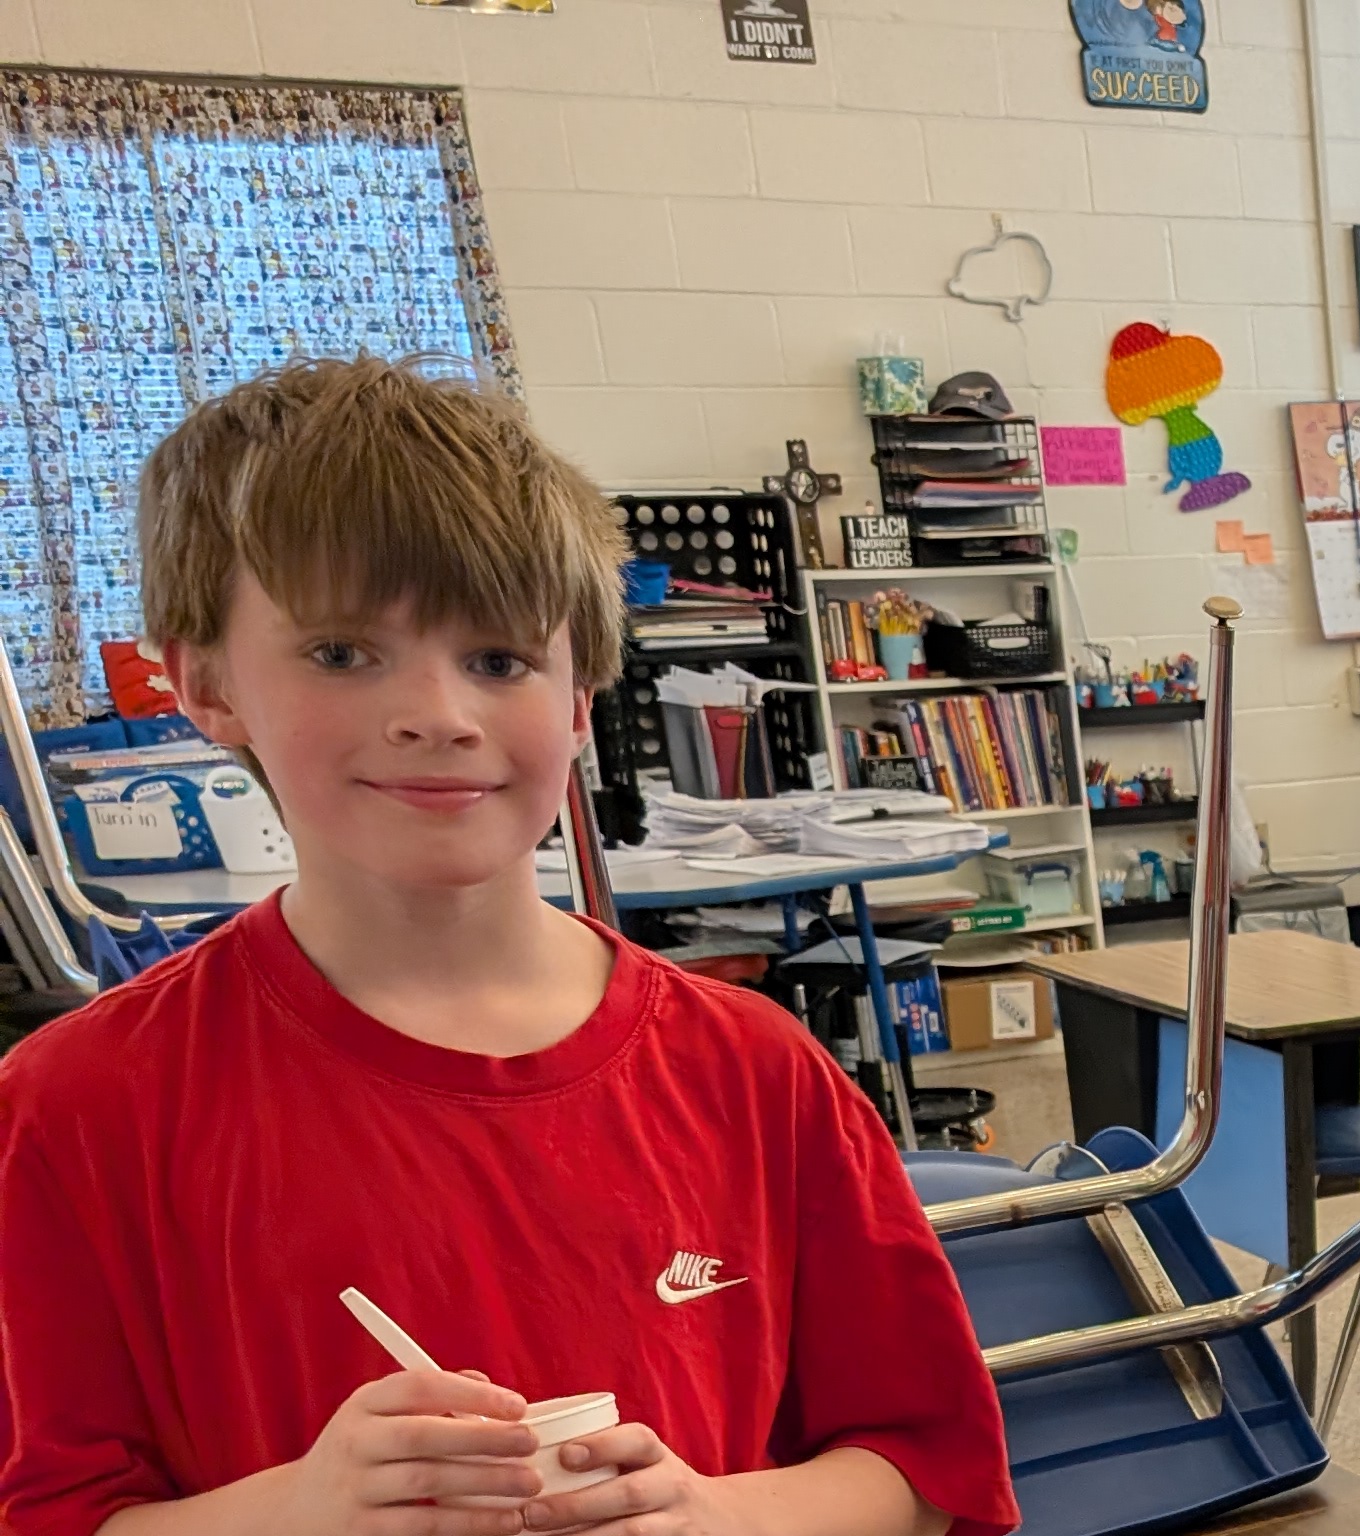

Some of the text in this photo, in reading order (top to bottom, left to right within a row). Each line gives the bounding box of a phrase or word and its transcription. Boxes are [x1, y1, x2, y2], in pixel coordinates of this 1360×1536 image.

[730, 19, 804, 46] I DIDN'T
[727, 43, 814, 60] WANT TO COME
[1091, 67, 1200, 105] SUCCEED
[847, 515, 909, 538] I TEACH
[850, 538, 911, 551] TOMORROW'S
[851, 549, 913, 568] LEADERS
[94, 806, 158, 828] Turn in
[666, 1250, 724, 1287] NIKE
